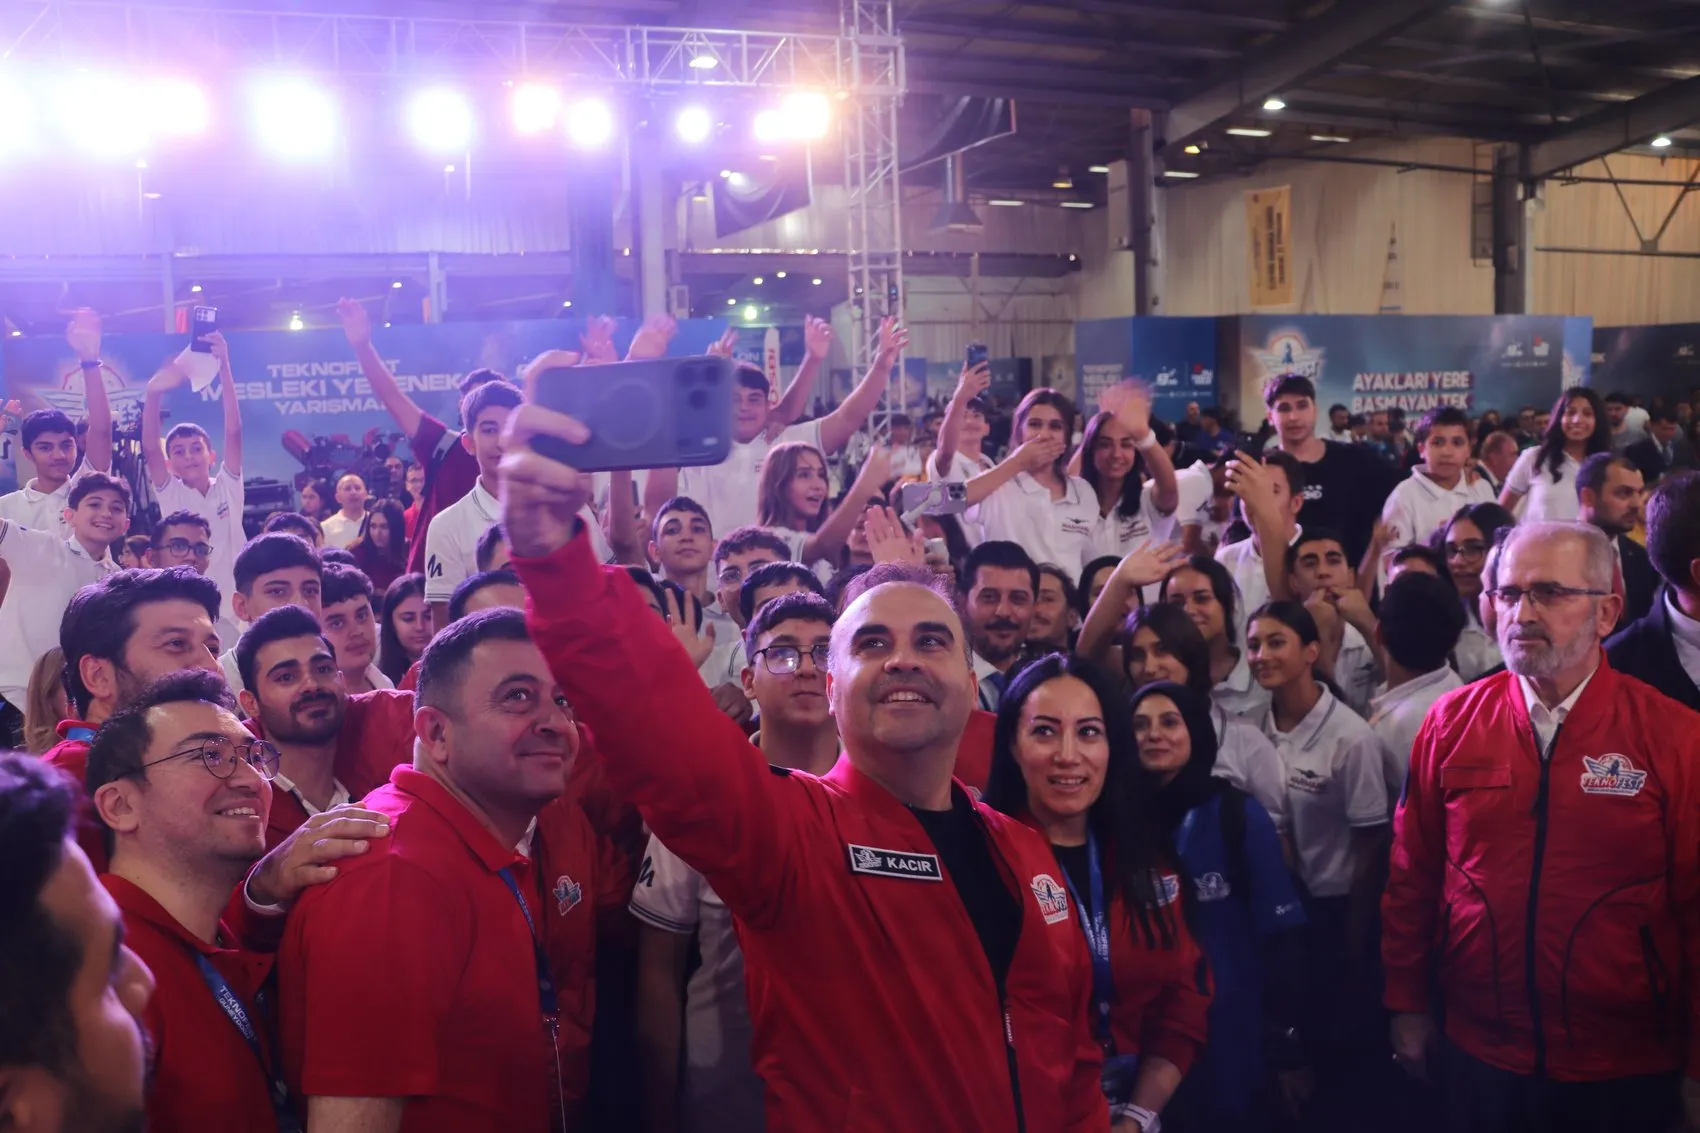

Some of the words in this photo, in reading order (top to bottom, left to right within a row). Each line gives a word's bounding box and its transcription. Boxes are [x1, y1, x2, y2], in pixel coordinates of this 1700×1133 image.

[267, 360, 400, 378] TEKNOFT
[331, 373, 463, 397] YEENEK
[1353, 373, 1428, 390] AYAKLARI
[1433, 372, 1469, 388] YERE
[273, 398, 385, 416] YARIŞMA
[1353, 395, 1436, 414] BASMAYAN
[886, 857, 933, 872] KACIR
